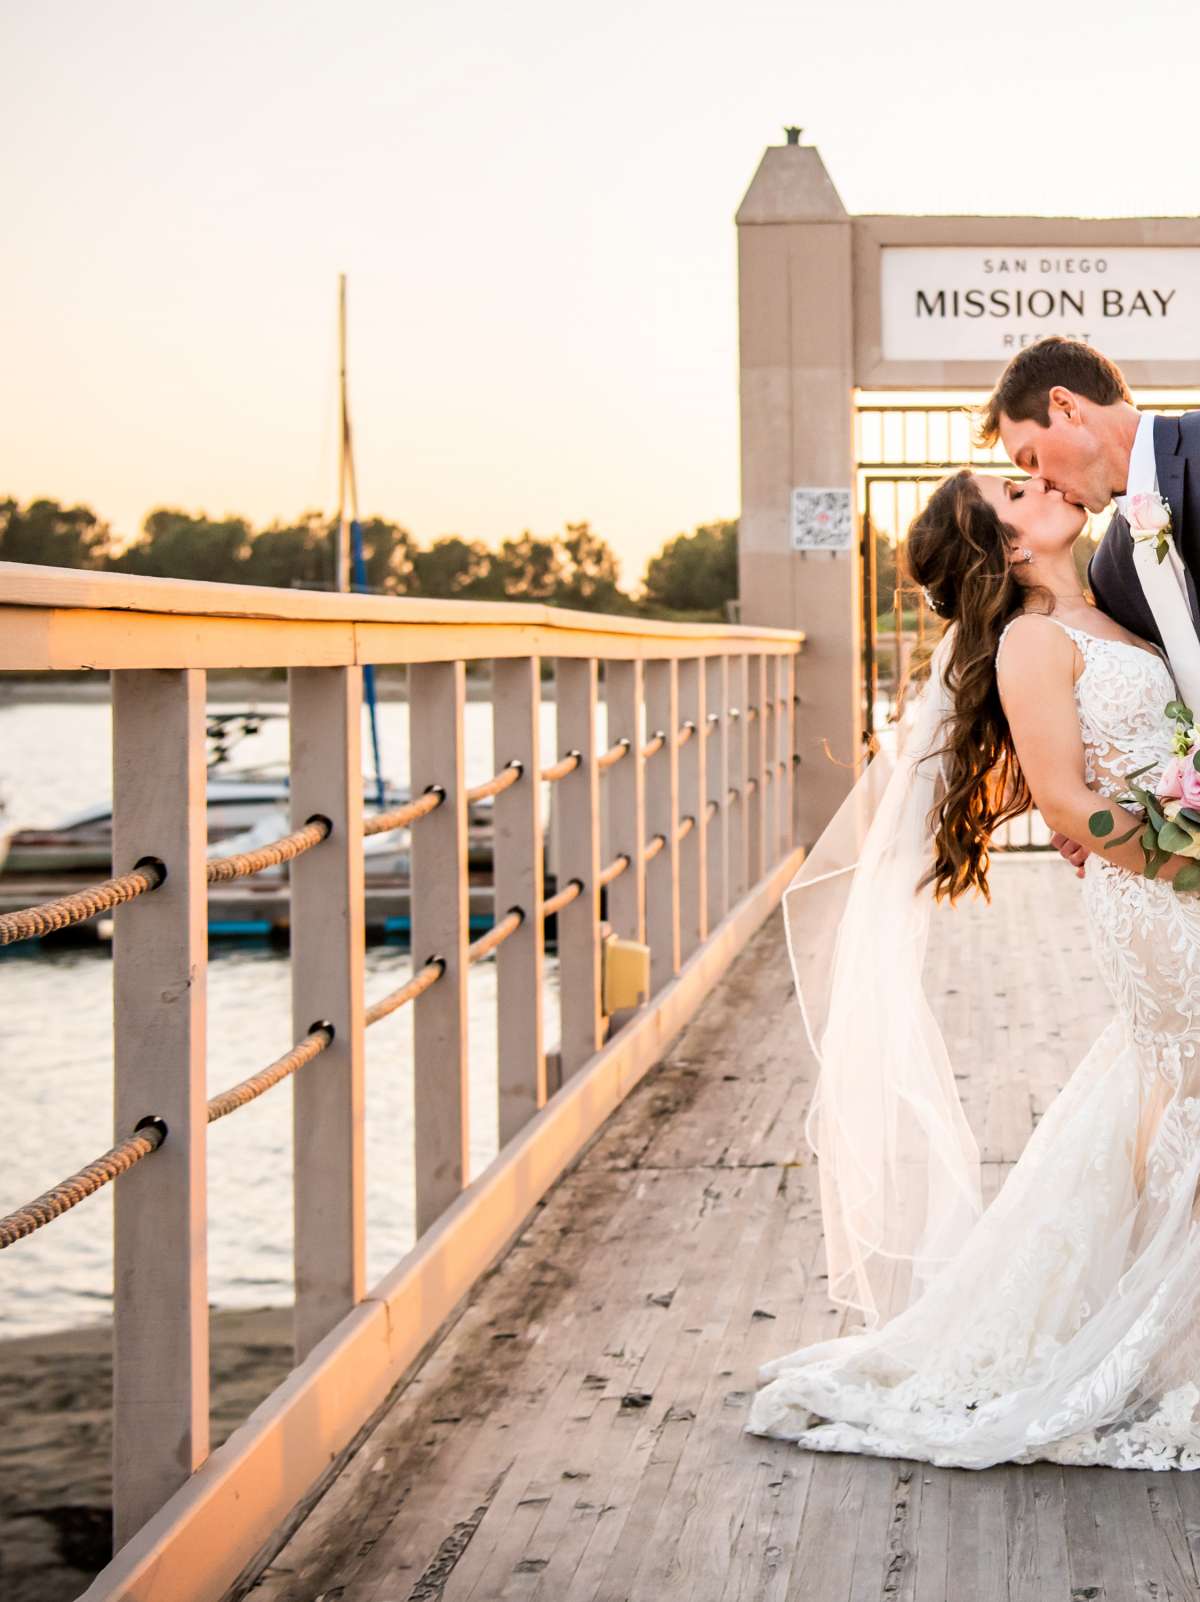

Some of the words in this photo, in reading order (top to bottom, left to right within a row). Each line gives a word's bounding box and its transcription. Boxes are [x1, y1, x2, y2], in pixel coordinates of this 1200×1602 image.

[983, 259, 1027, 274] SAN
[1039, 259, 1108, 274] DIEGO
[915, 289, 1085, 319] MISSION
[1101, 289, 1176, 319] BAY
